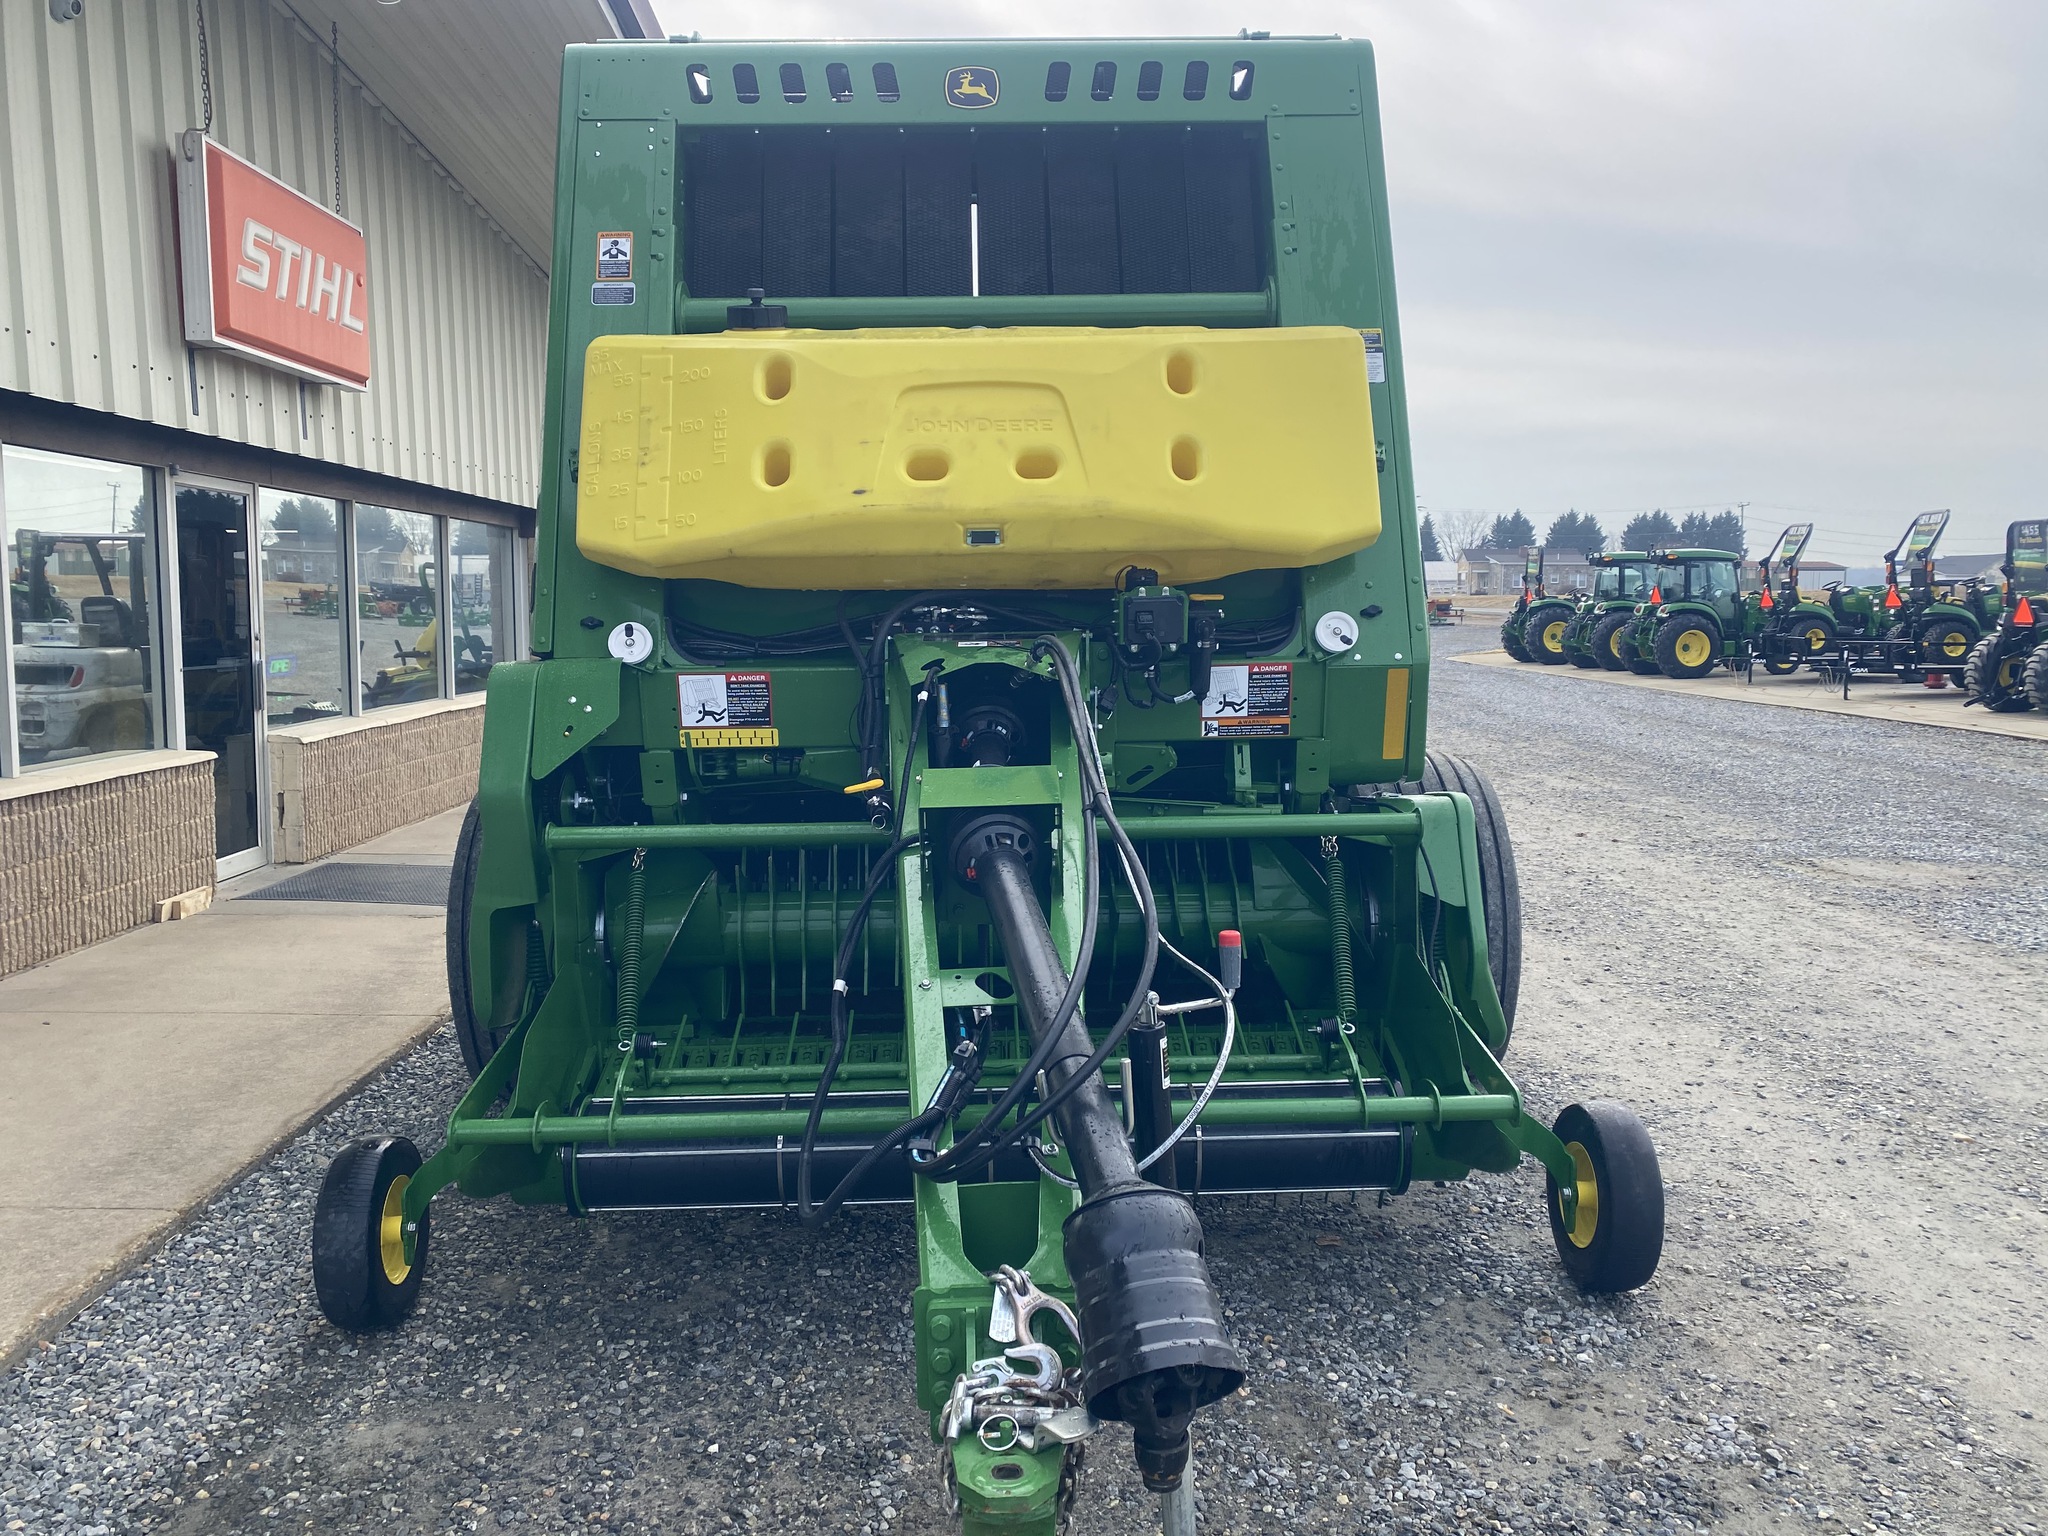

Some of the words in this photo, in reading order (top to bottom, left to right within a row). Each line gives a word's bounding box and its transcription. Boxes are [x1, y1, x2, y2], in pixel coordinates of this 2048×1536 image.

[236, 217, 364, 335] STIHL
[590, 360, 622, 376] MAX
[679, 366, 711, 384] 200
[613, 372, 634, 387] 55
[679, 418, 704, 434] 150
[906, 417, 969, 433] JOHN
[975, 417, 1054, 432] DEERE
[713, 408, 728, 465] LITERS
[585, 421, 602, 497] GALLONS
[610, 447, 632, 462] 35
[677, 469, 703, 484] 100
[608, 482, 631, 498] 25
[613, 516, 629, 530] 15
[674, 512, 697, 527] 50
